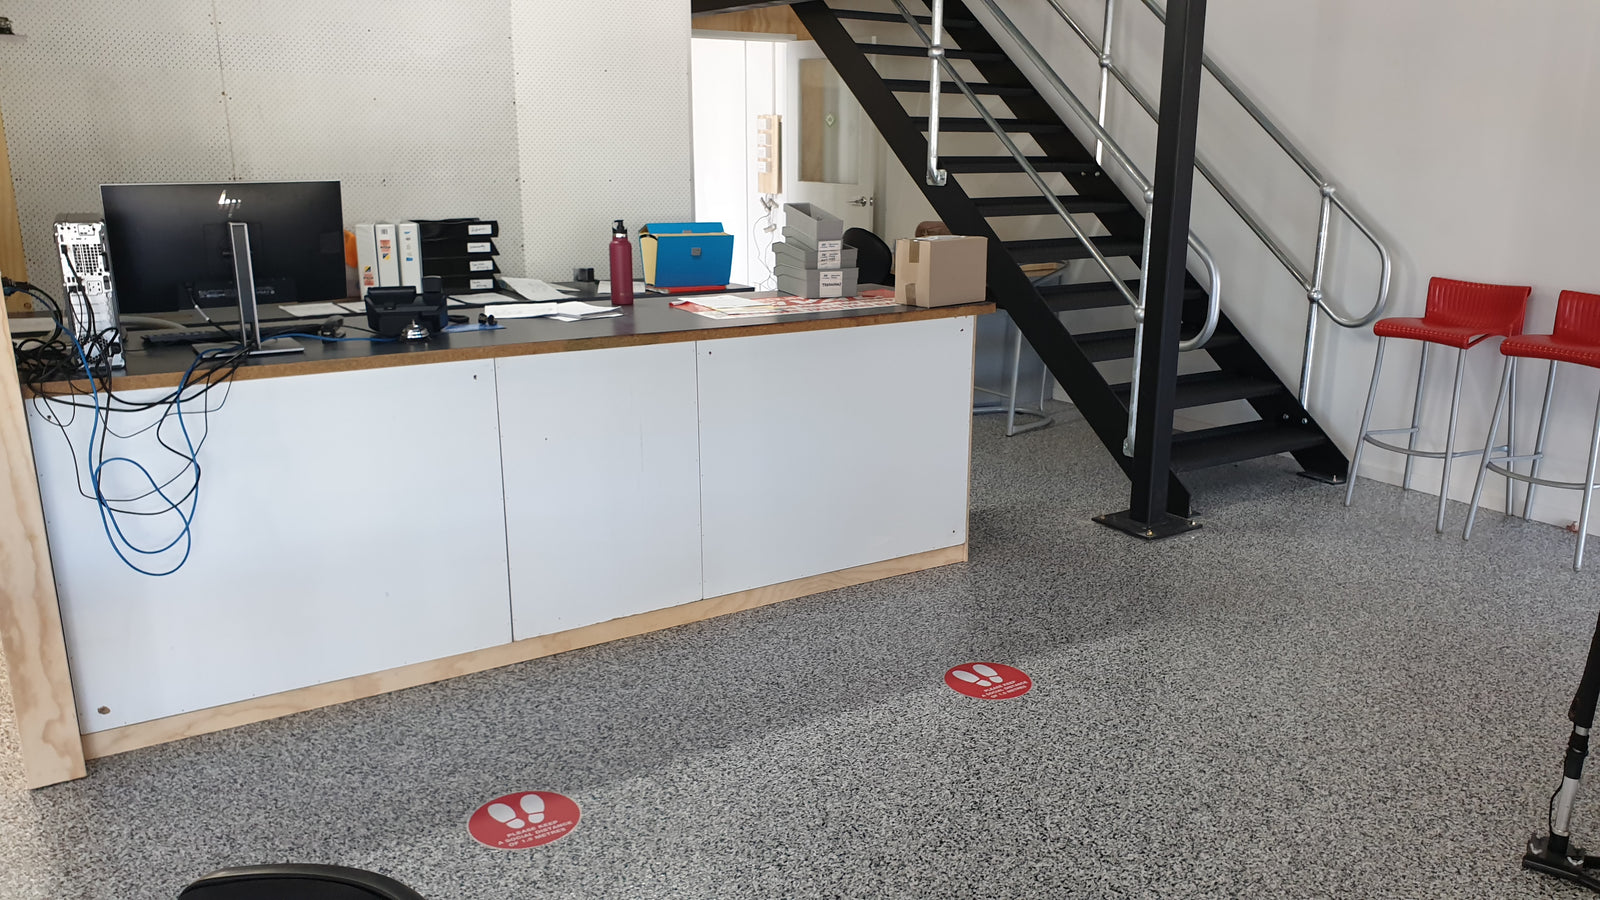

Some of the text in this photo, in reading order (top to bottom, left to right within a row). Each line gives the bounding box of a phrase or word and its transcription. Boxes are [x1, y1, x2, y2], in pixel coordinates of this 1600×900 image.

[505, 832, 534, 842] SOCIAL
[535, 821, 573, 834] DISTANCE
[506, 820, 558, 838] PLEASE KEEP
[534, 828, 566, 839] METRES
